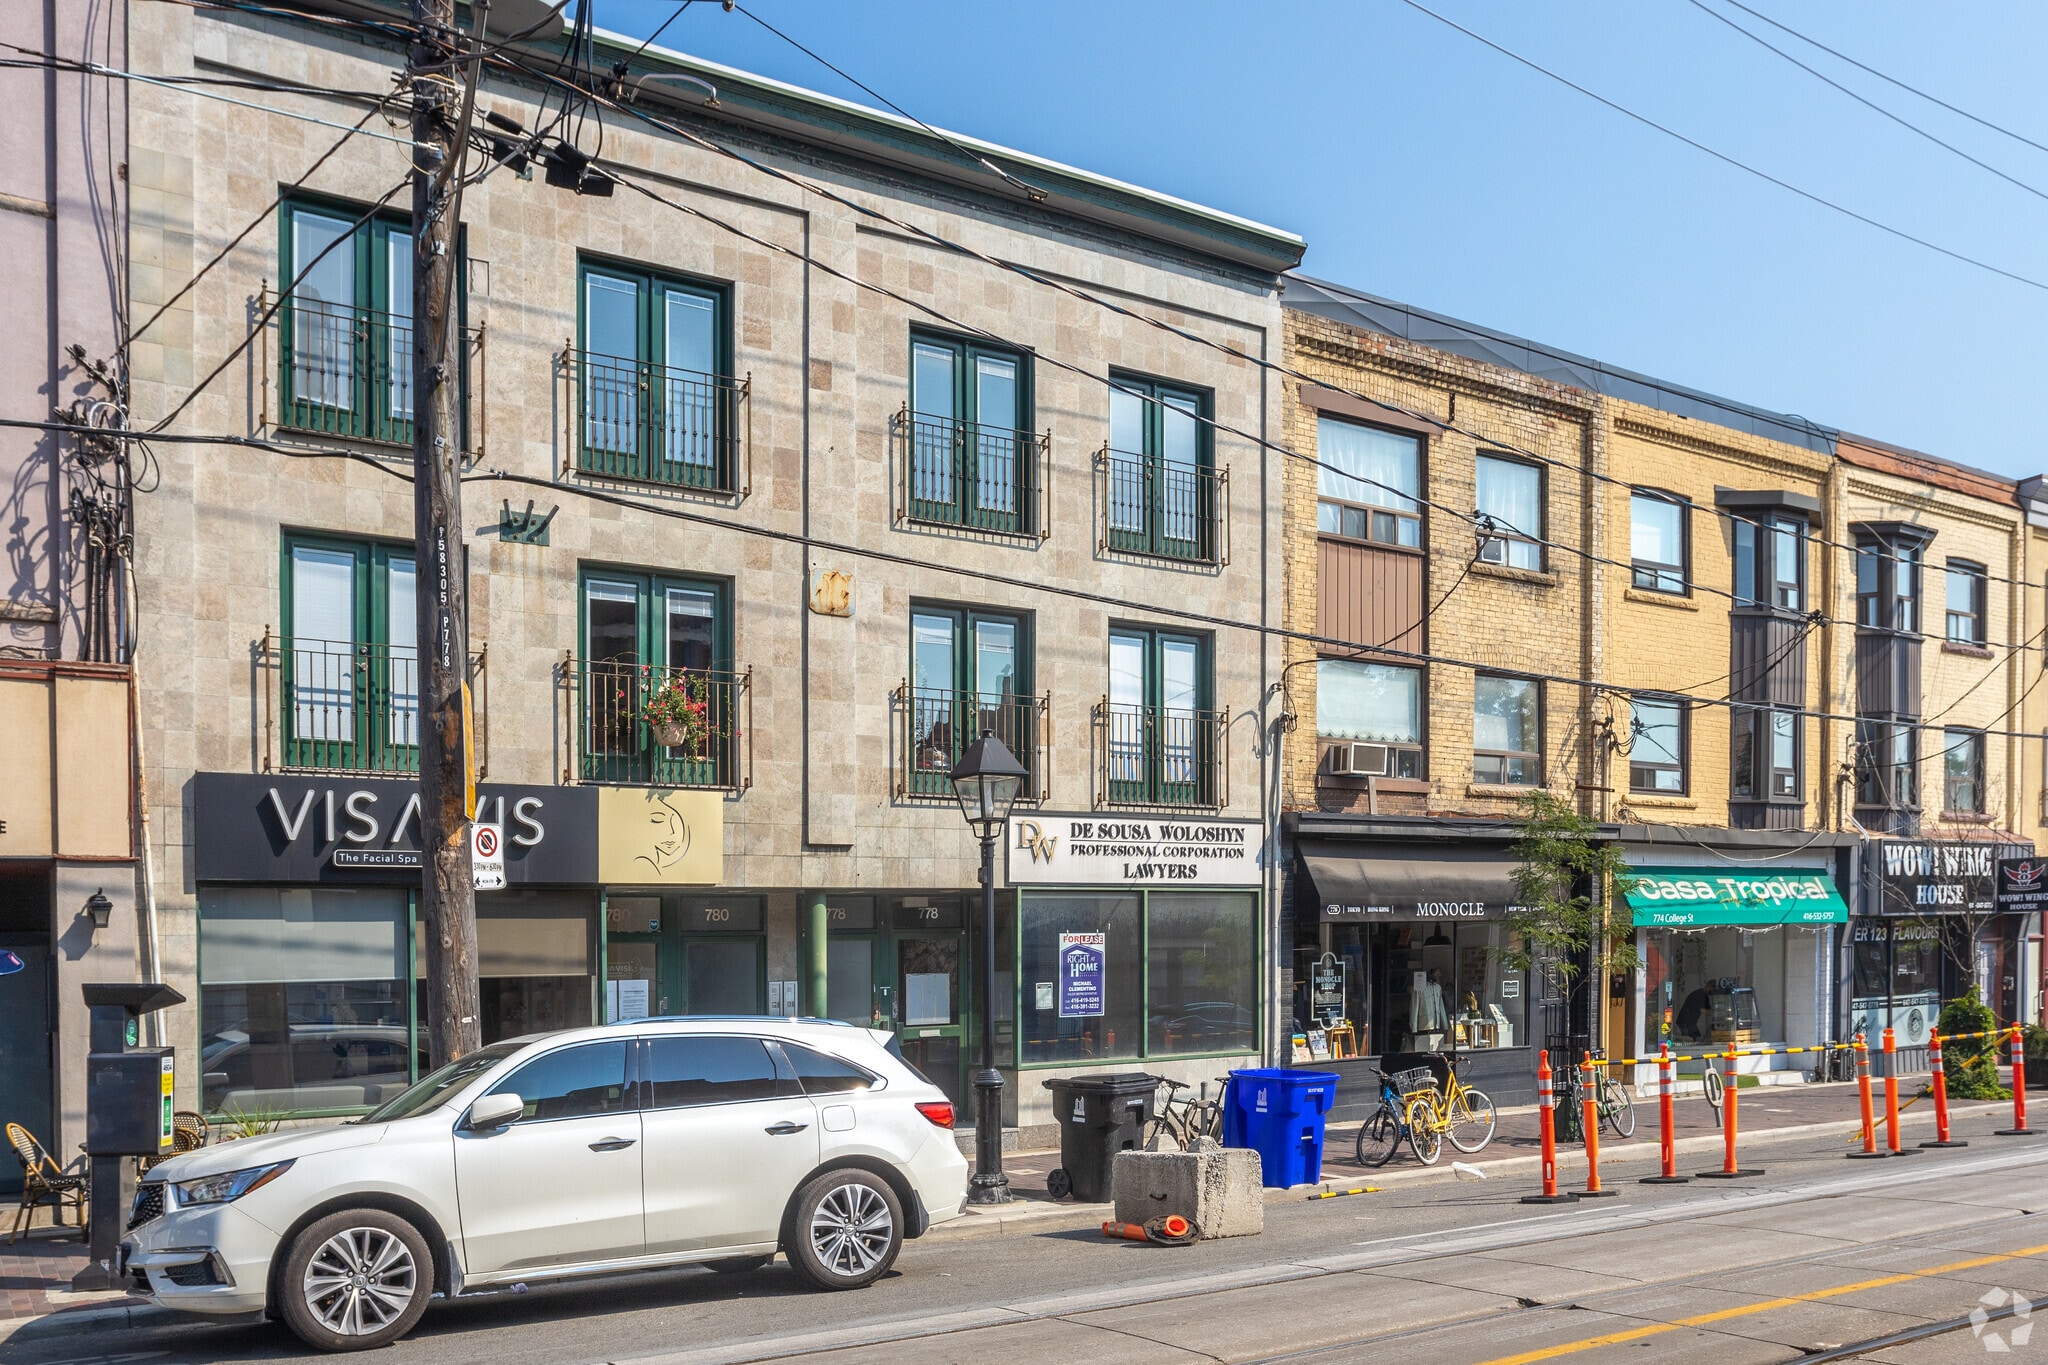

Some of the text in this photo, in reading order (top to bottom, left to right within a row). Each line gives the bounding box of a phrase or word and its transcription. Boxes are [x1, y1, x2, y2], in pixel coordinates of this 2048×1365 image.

[1070, 822, 1245, 843] DE SOUSA WOLOSHYN
[1070, 844, 1245, 859] PROFESSIONAL CORPORATION
[339, 853, 417, 866] The Facial Spa
[1123, 863, 1198, 880] LAWYERS
[1638, 877, 1715, 901] Casa
[1716, 876, 1830, 907] Tropical
[1915, 884, 1964, 905] HOUSE
[1999, 895, 2024, 903] WOW!
[918, 907, 939, 920] 778
[1416, 902, 1485, 917] MONOCLE
[2009, 903, 2038, 911] HOUSE
[705, 908, 730, 922] 780
[1653, 913, 1664, 924] 774
[1664, 913, 1687, 924] College
[1687, 912, 1694, 924] St
[1063, 934, 1104, 945] FOR LEASE
[1870, 927, 1888, 942] 123
[1893, 925, 1940, 941] FLAVOURS
[1067, 954, 1090, 964] RIGHT
[1070, 962, 1098, 978] HOME
